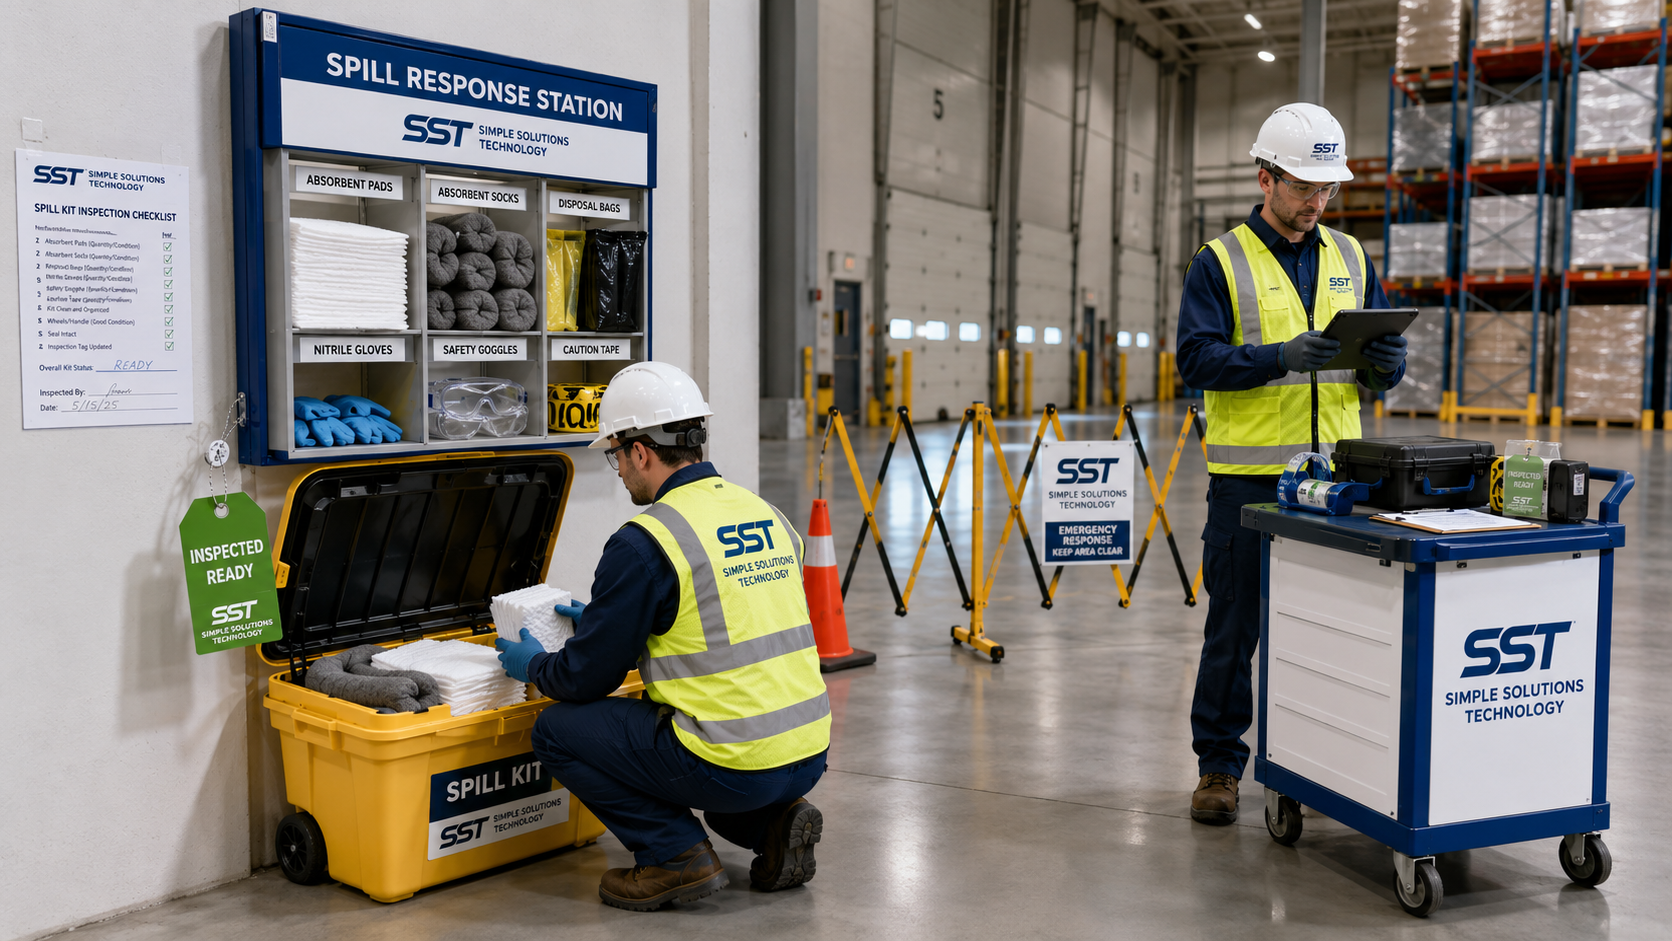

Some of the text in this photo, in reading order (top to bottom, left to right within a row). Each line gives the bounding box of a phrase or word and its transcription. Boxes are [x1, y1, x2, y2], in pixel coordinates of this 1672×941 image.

[326, 51, 623, 122] SPILL RESPONSE STATION
[933, 89, 944, 121] 5
[402, 113, 474, 147] SST
[478, 124, 570, 146] SIMPLE SOLUTIONS
[479, 138, 548, 157] TECHNOLOGY
[1312, 143, 1339, 153] SST
[33, 164, 84, 186] SST
[88, 169, 165, 184] SIMPLE SOLUTIONS
[306, 173, 393, 193] ABSORBENT PADS
[89, 179, 144, 191] TECHNOLOGY
[438, 186, 520, 204] ABSORBENT SOCKS
[34, 203, 177, 222] SPILL KIT INSPECTION CHECKLIST
[558, 198, 621, 214] DISPOSAL BAGS
[1329, 277, 1351, 287] SST
[48, 330, 60, 338] Seal
[48, 343, 77, 351] Inspection
[78, 343, 88, 351] Tag
[89, 343, 112, 351] Updated
[314, 344, 393, 356] NITRILE GLOVES
[443, 344, 519, 356] SAFETY GOGGLES
[562, 344, 620, 356] CAUTION TAPE
[114, 359, 153, 371] READY
[39, 388, 86, 398] Inspected By:
[40, 404, 58, 412] Date:
[72, 399, 119, 413] 5/15/25
[1056, 457, 1120, 485] SST
[1048, 490, 1127, 499] SIMPLE SOLUTIONS
[1511, 496, 1533, 504] SST
[1059, 500, 1115, 509] TECHNOLOGY
[717, 519, 774, 558] SST
[1059, 525, 1117, 535] EMERGENCY
[1063, 535, 1113, 545] RESPONSE
[189, 538, 264, 564] INSPECTED
[1052, 547, 1123, 557] KEEP AREA CLEAR
[206, 563, 254, 585] READY
[723, 555, 794, 577] SIMPLE SOLUTIONS
[211, 599, 258, 626] SST
[201, 618, 273, 639] SIMPLE SOLUTIONS
[212, 629, 263, 645] TECHNOLOGY
[1460, 620, 1573, 679] SST
[1445, 679, 1584, 706] SIMPLE SOLUTIONS
[1465, 700, 1564, 724] TECHNOLOGY
[446, 760, 542, 803] SPILL KIT
[493, 798, 562, 823] SIMPLE SOLUTIONS
[494, 813, 544, 833] TECHNOLOGY
[439, 816, 490, 850] SST
